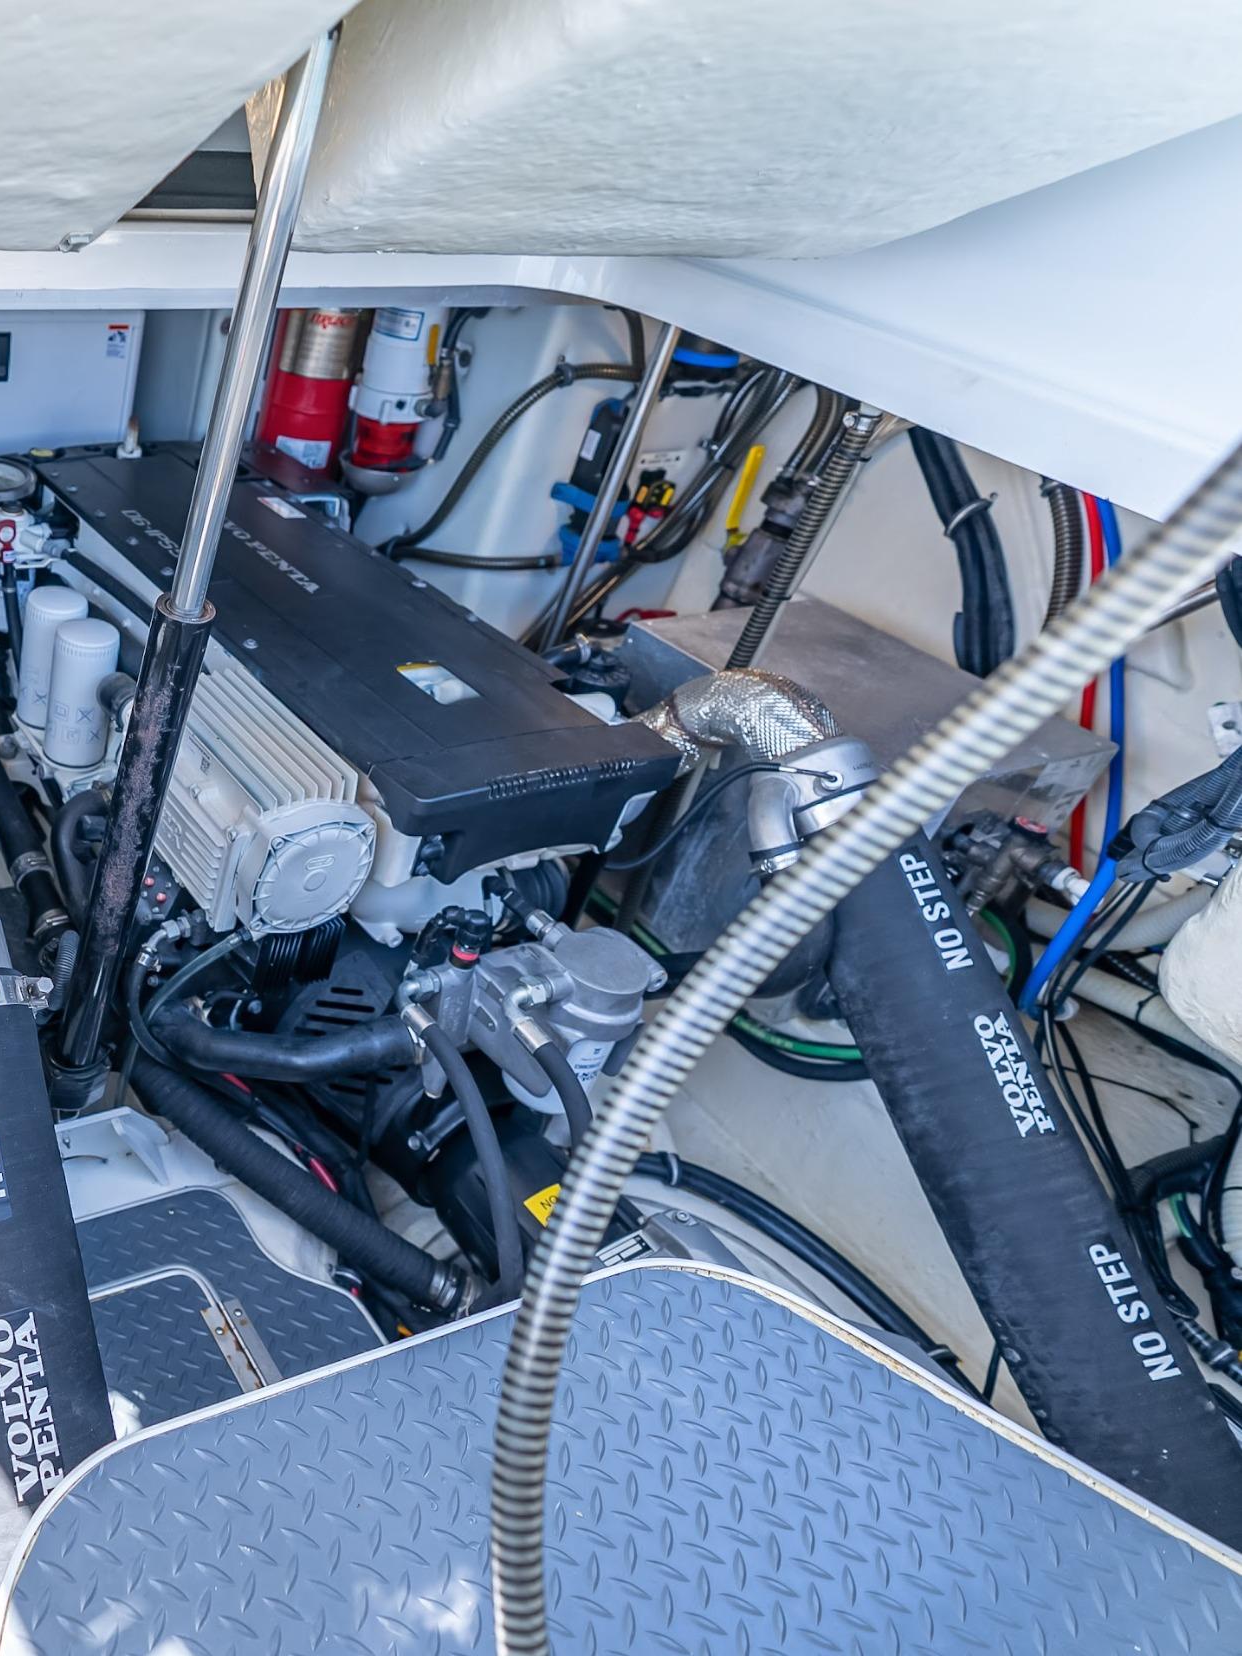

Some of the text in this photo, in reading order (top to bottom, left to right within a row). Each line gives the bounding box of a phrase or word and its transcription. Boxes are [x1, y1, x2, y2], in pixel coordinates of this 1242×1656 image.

[245, 541, 321, 595] PENTA
[899, 853, 974, 971] NO STEP
[973, 1014, 1036, 1138] VOLVO
[993, 1011, 1056, 1134] PENTA
[540, 1195, 558, 1210] NO
[1088, 1243, 1182, 1381] NO STEP
[14, 1311, 64, 1496] PENTA
